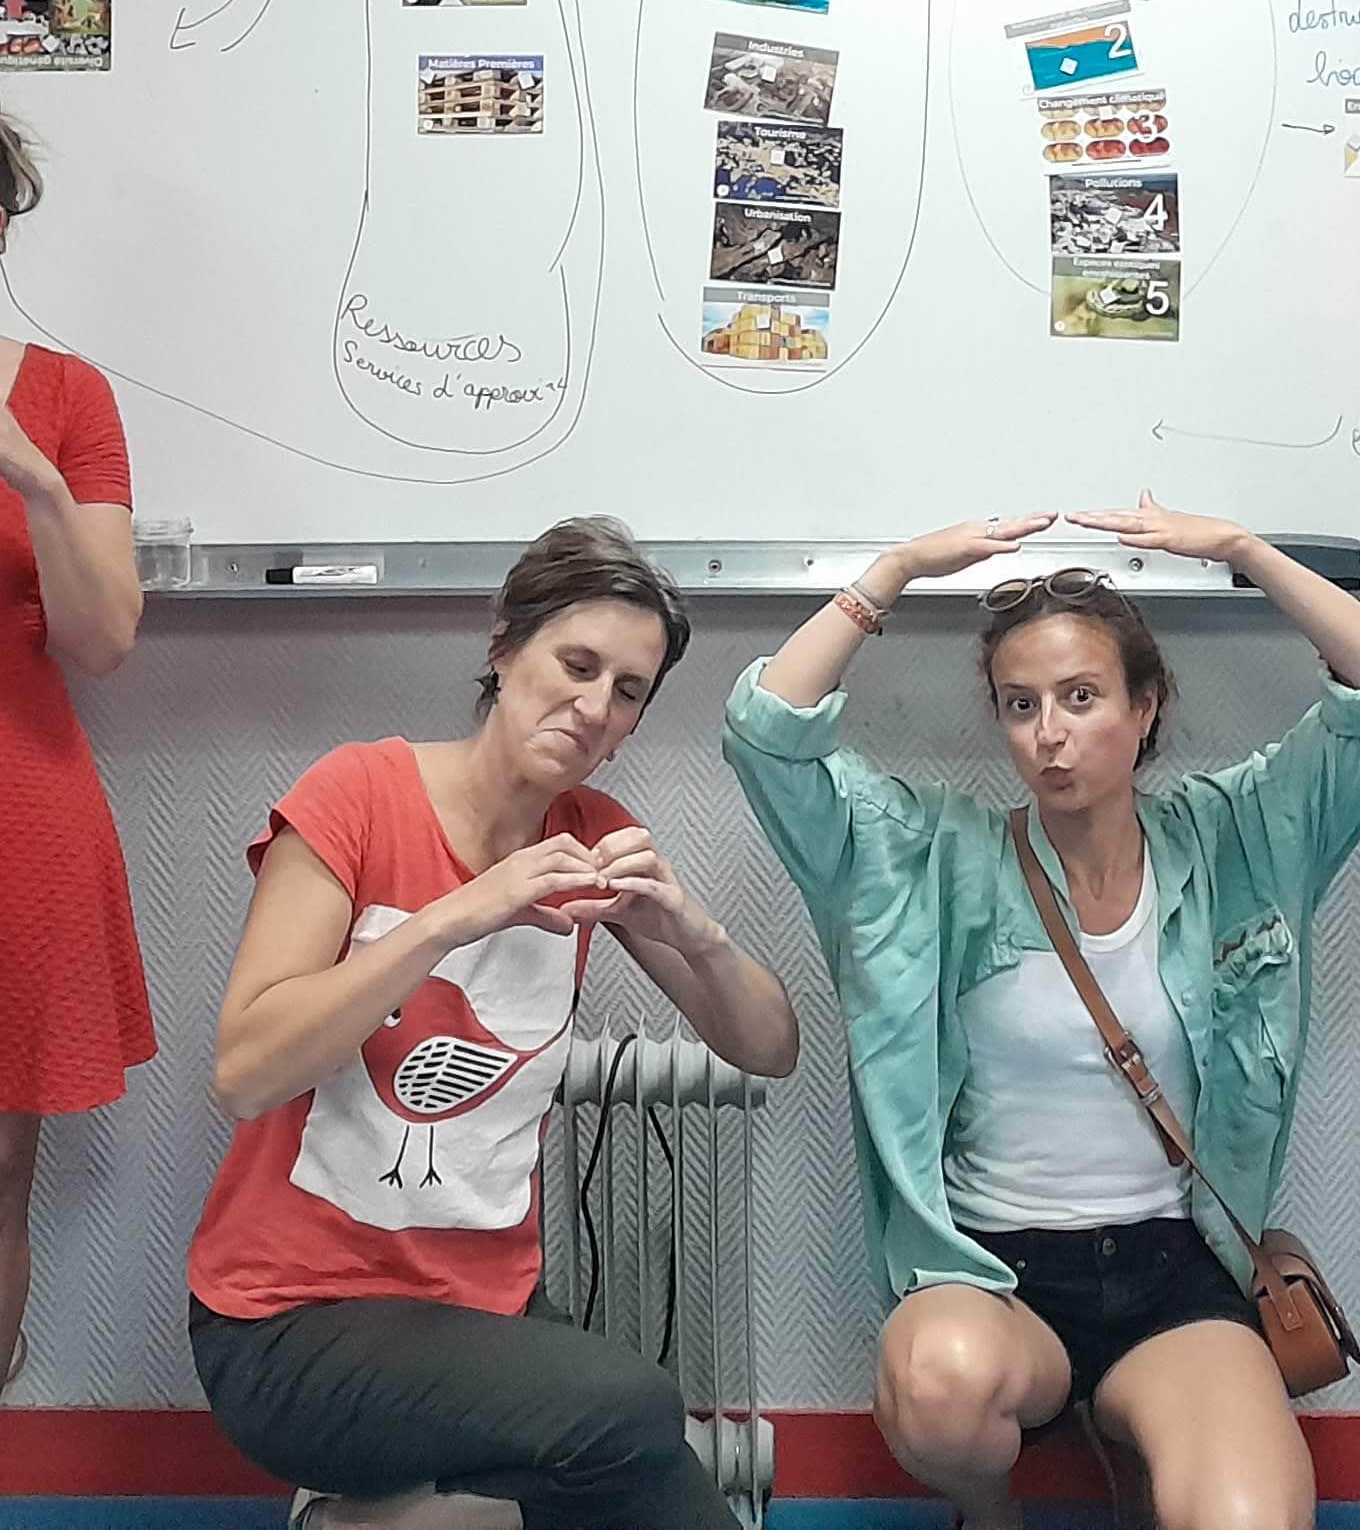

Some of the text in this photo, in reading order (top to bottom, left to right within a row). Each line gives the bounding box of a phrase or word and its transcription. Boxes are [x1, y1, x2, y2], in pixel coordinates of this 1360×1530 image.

[748, 40, 804, 58] Industries
[1103, 23, 1132, 59] 2
[427, 57, 535, 70] Matières Premières
[754, 126, 807, 140] Tourisme
[1138, 112, 1159, 143] 3
[1084, 177, 1143, 189] Pollutions
[744, 207, 812, 223] Urbanisation
[1143, 193, 1169, 232] 4
[1145, 280, 1170, 316] 5
[340, 294, 522, 363] Ressources
[343, 340, 422, 396] Services
